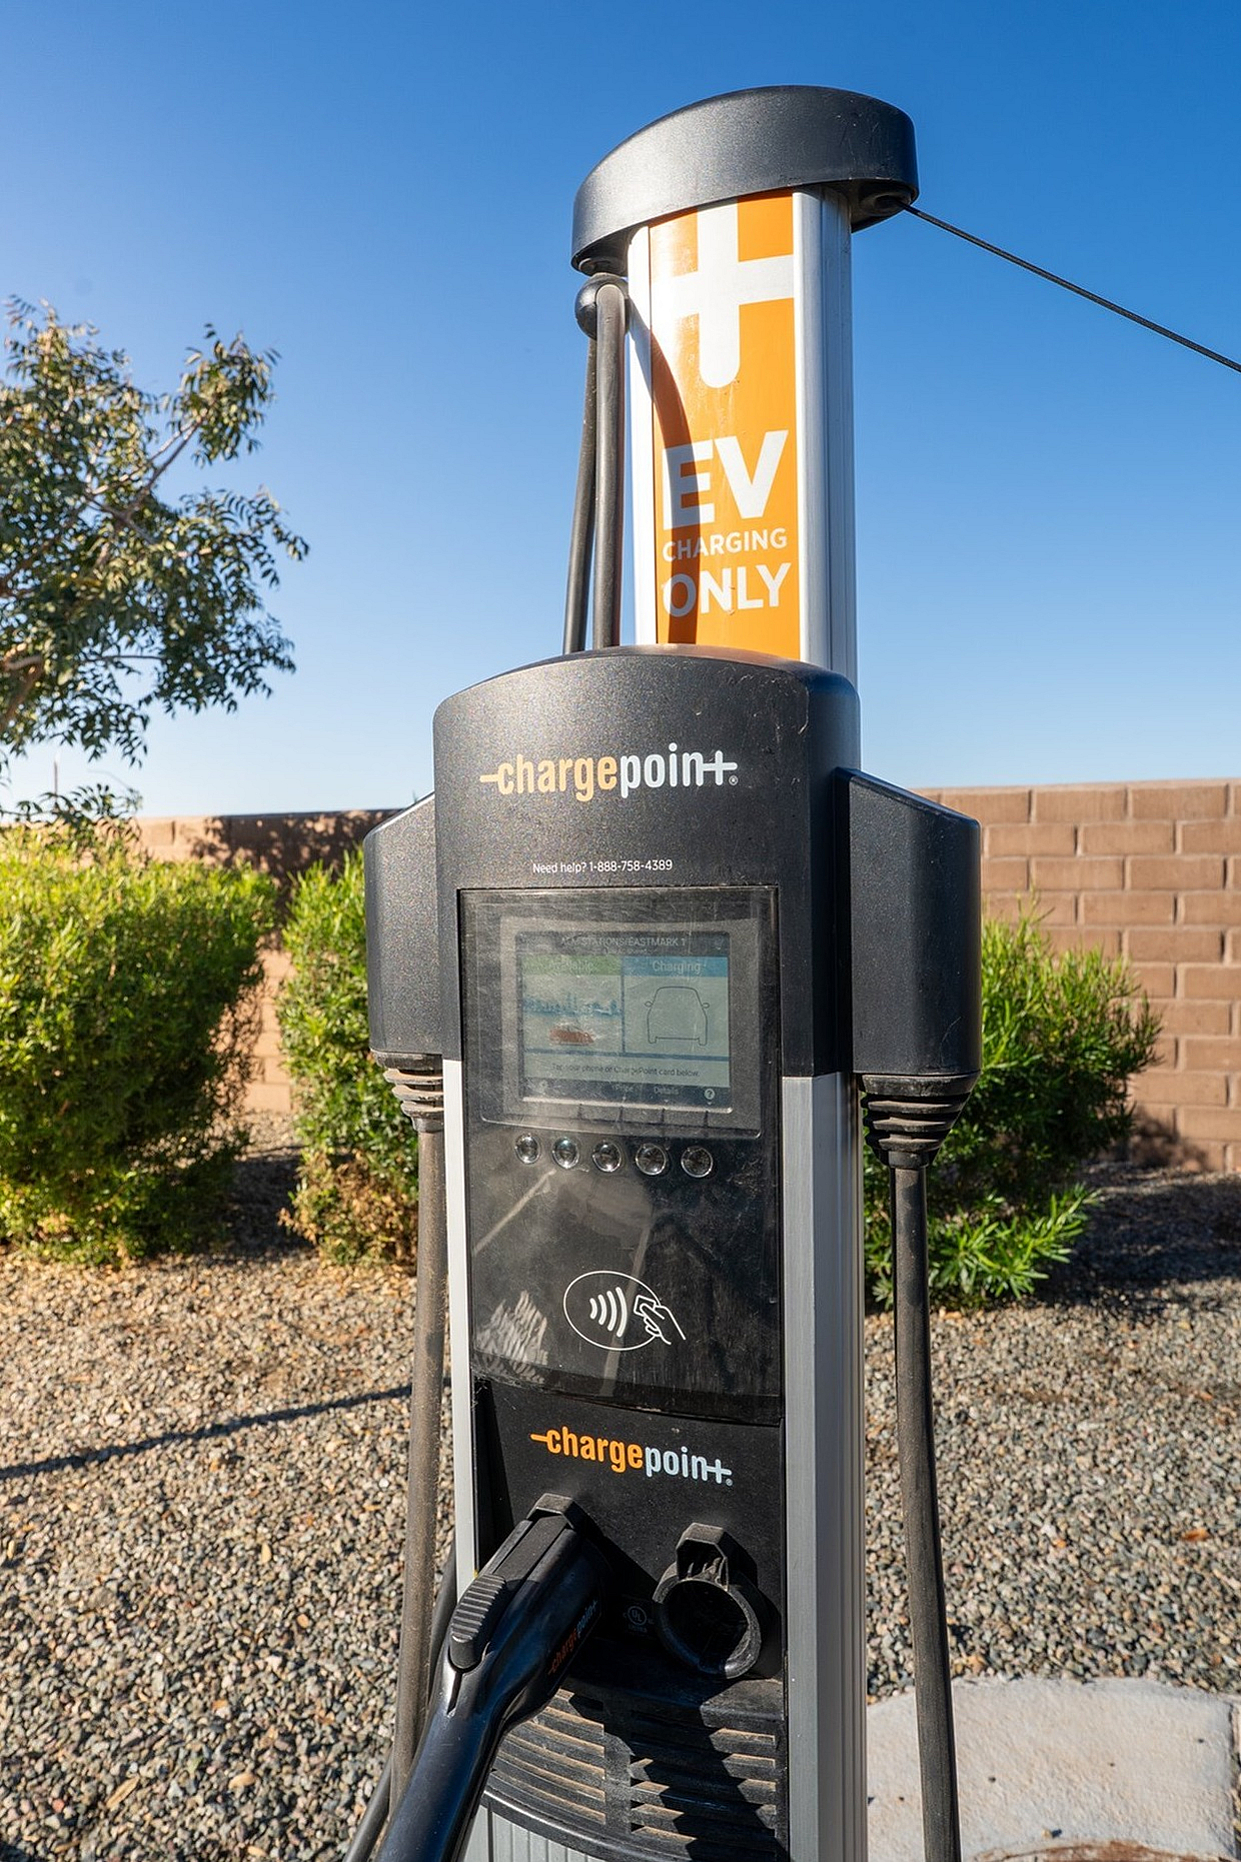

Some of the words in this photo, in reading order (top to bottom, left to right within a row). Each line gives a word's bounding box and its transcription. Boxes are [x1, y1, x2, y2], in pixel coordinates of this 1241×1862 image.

[662, 430, 789, 530] EV
[662, 528, 787, 562] CHARGING
[662, 562, 791, 617] ONLY
[532, 862, 557, 873] Need
[560, 862, 587, 874] help?
[589, 859, 673, 872] 1-888-758-4389
[652, 960, 701, 975] Charging
[659, 1068, 676, 1076] card
